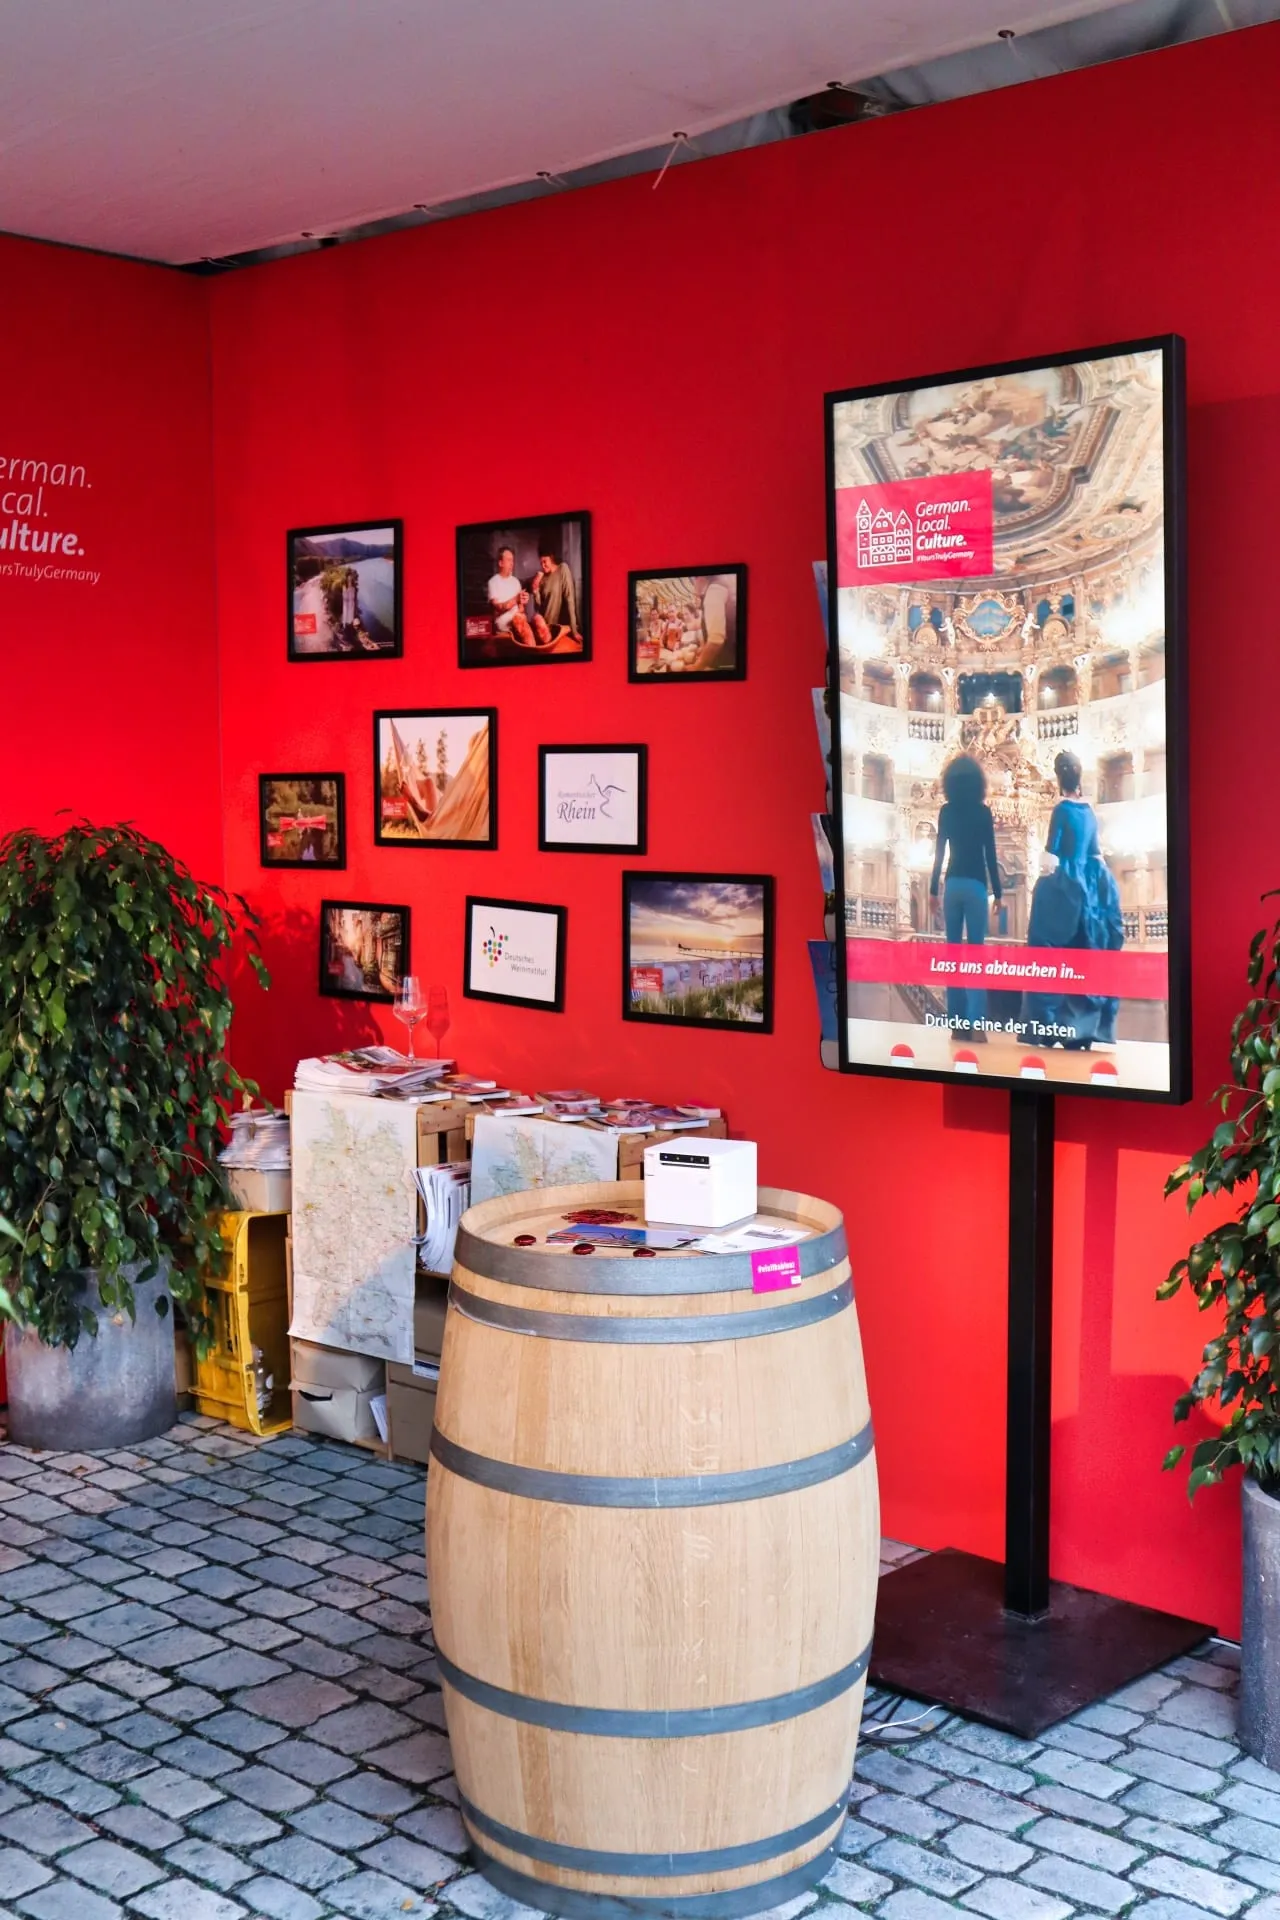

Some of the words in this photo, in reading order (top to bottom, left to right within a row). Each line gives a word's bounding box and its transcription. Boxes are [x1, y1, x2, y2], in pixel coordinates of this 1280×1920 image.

[2, 486, 48, 517] cal.
[915, 500, 971, 517] German.
[916, 515, 951, 533] Local.
[916, 533, 967, 550] Culture.
[0, 562, 100, 585] rsTrulyGermany
[557, 799, 596, 823] Rhein
[504, 952, 535, 964] Deutsches
[930, 957, 956, 973] Lass
[959, 961, 982, 974] uns
[985, 960, 1056, 978] abtauchen
[1060, 963, 1085, 980] in...
[925, 1013, 970, 1031] Drücke
[973, 1017, 1002, 1032] eine
[1005, 1018, 1027, 1034] der
[1030, 1020, 1076, 1038] Tasten
